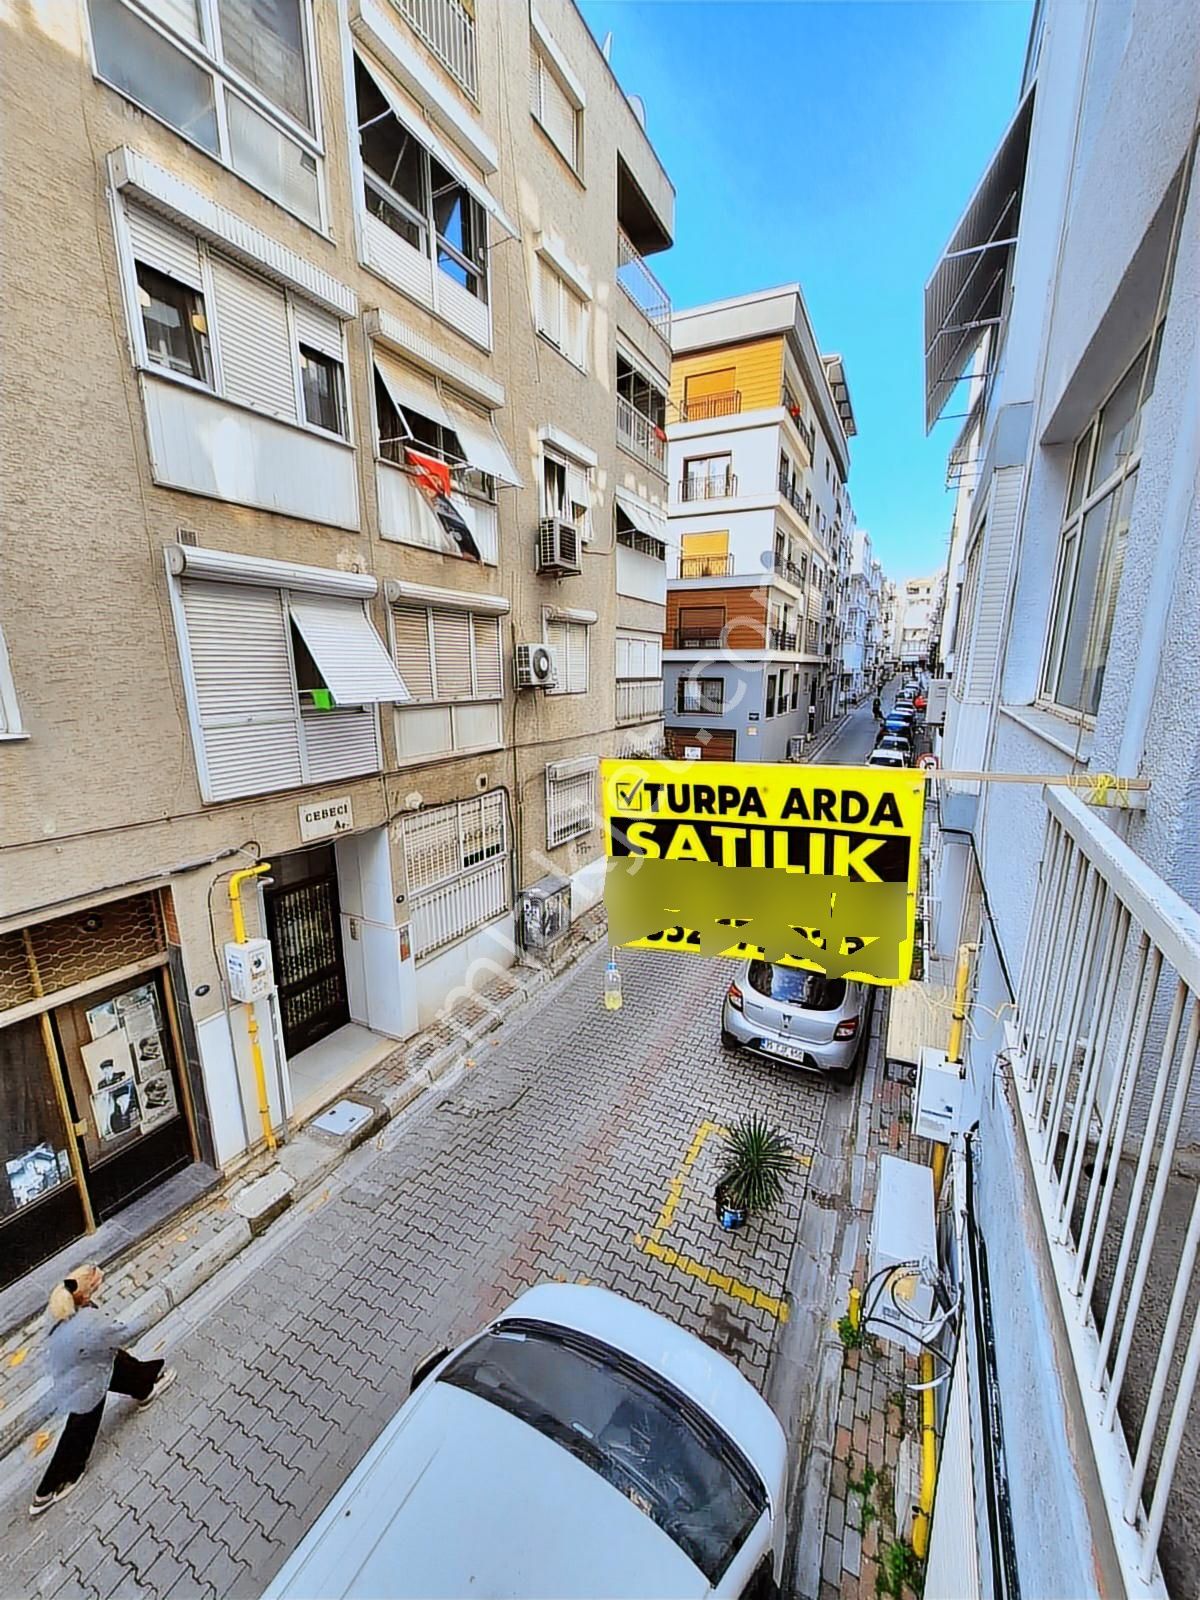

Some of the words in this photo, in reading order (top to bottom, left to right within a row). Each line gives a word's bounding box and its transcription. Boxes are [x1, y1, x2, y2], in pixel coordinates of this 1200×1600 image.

[644, 782, 767, 818] TURPA
[781, 787, 904, 828] ARDA
[627, 821, 888, 882] SATILIK
